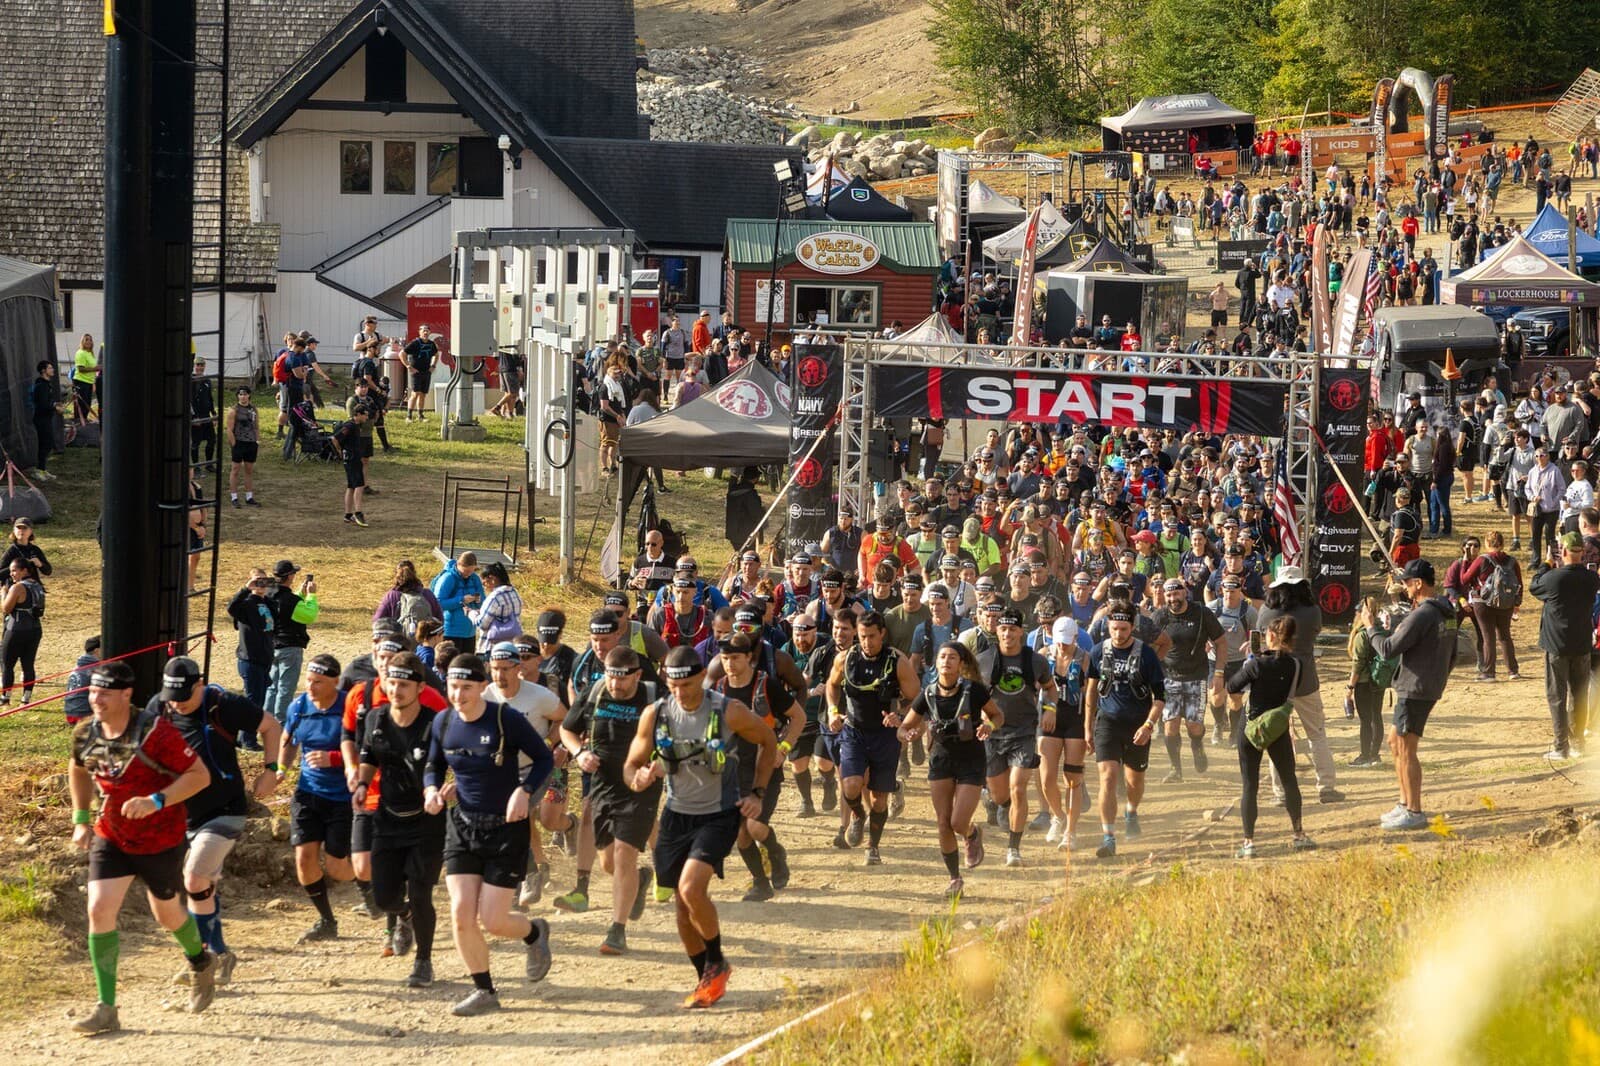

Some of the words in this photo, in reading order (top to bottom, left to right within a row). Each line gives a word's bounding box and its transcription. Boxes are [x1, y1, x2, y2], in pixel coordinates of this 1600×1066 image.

[1436, 105, 1447, 143] SPARTAN
[1328, 140, 1359, 150] KIDS
[1540, 230, 1569, 241] Ford
[814, 238, 863, 252] Waffle
[815, 251, 860, 266] Cabin
[1497, 289, 1560, 298] LOCKERHOUSE
[798, 399, 824, 411] NAVY
[966, 376, 1191, 424] START
[1328, 526, 1358, 535] givestar
[1320, 544, 1355, 552] GOVX
